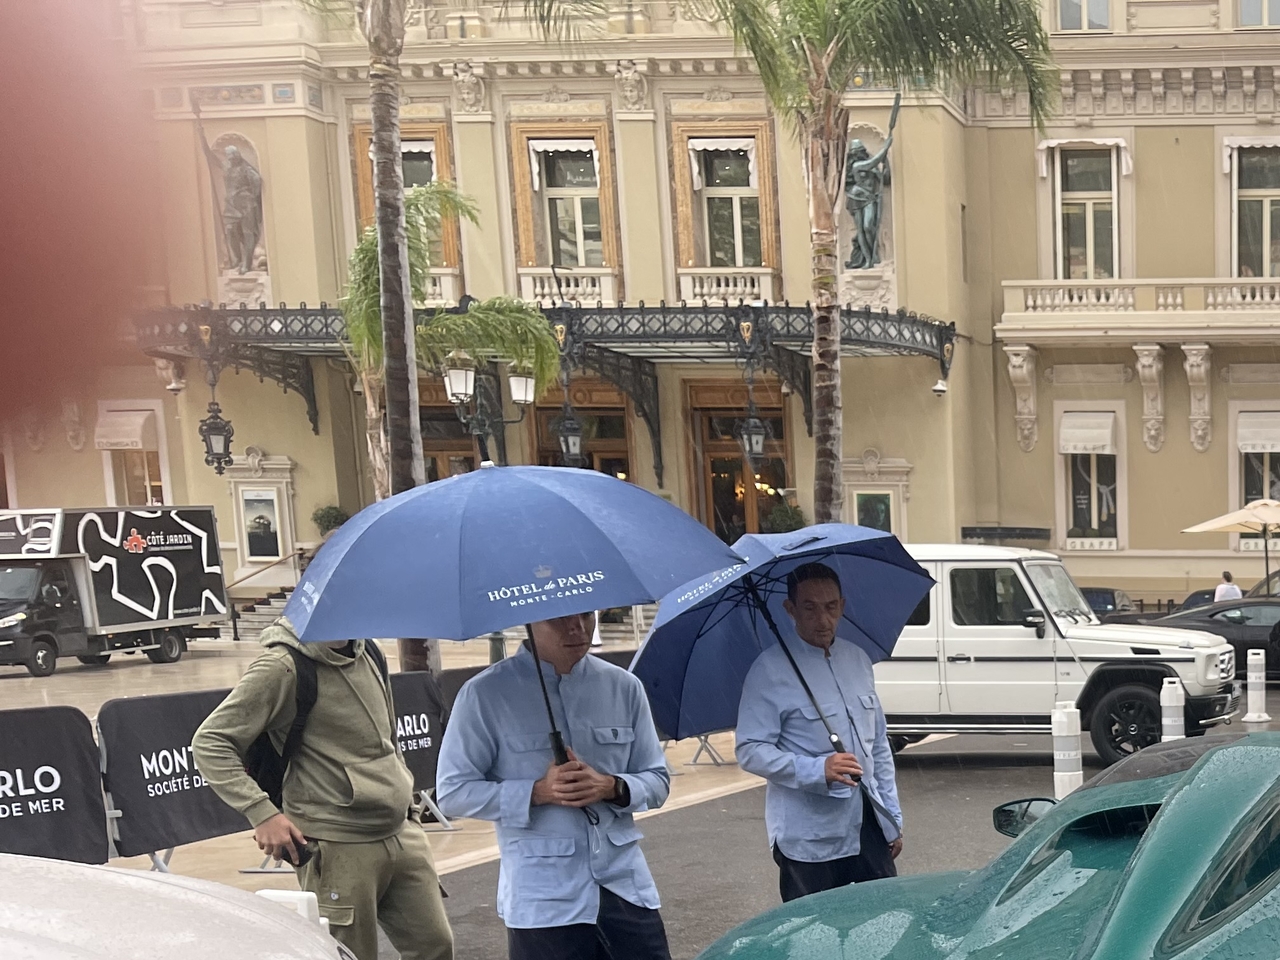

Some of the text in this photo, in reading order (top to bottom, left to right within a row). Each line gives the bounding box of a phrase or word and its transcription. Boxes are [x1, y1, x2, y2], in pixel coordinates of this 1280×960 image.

[1062, 444, 1107, 452] GRAFF
[146, 531, 192, 545] CÔTÉ JARDIN
[1070, 541, 1113, 549] GRAFF
[487, 570, 605, 602] HÔTEL de PARIS
[396, 713, 429, 738] ARLO
[140, 746, 198, 780] MON
[0, 765, 62, 799] RLO
[147, 774, 191, 797] SOCIÉTÉ
[28, 798, 65, 814] MER
